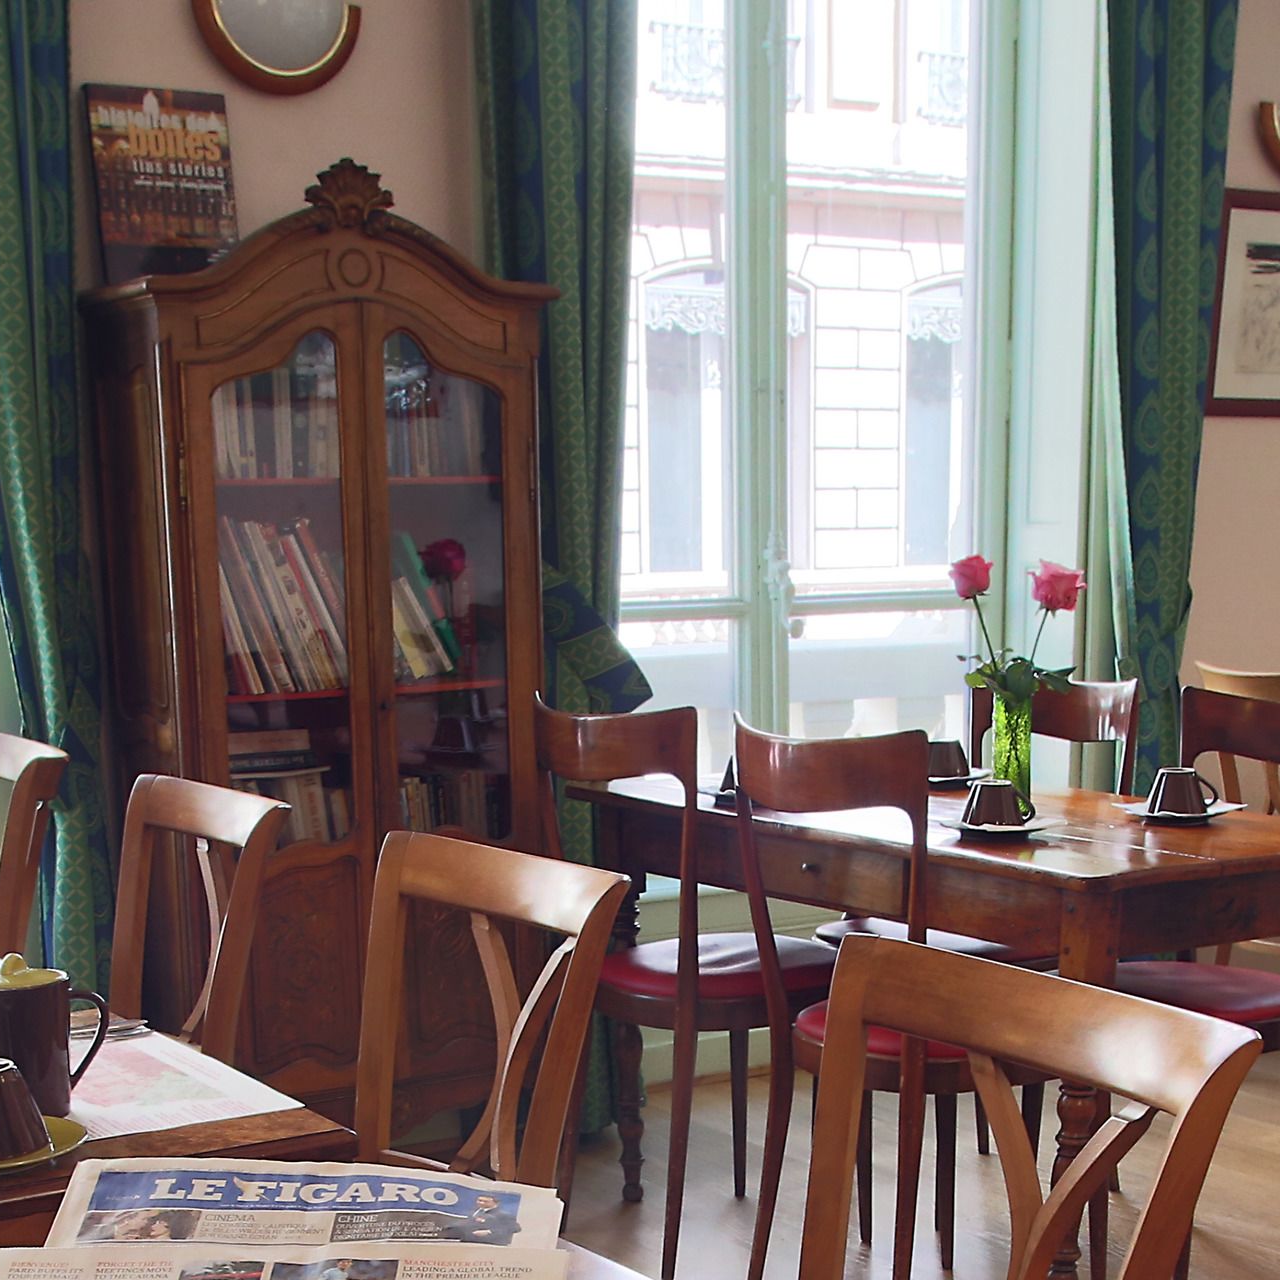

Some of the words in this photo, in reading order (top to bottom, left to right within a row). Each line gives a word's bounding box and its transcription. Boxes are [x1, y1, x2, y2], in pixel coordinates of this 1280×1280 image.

[169, 161, 224, 178] stories
[148, 1178, 227, 1201] LE
[233, 1176, 459, 1207] FIGARO
[337, 1214, 379, 1223] CHINE
